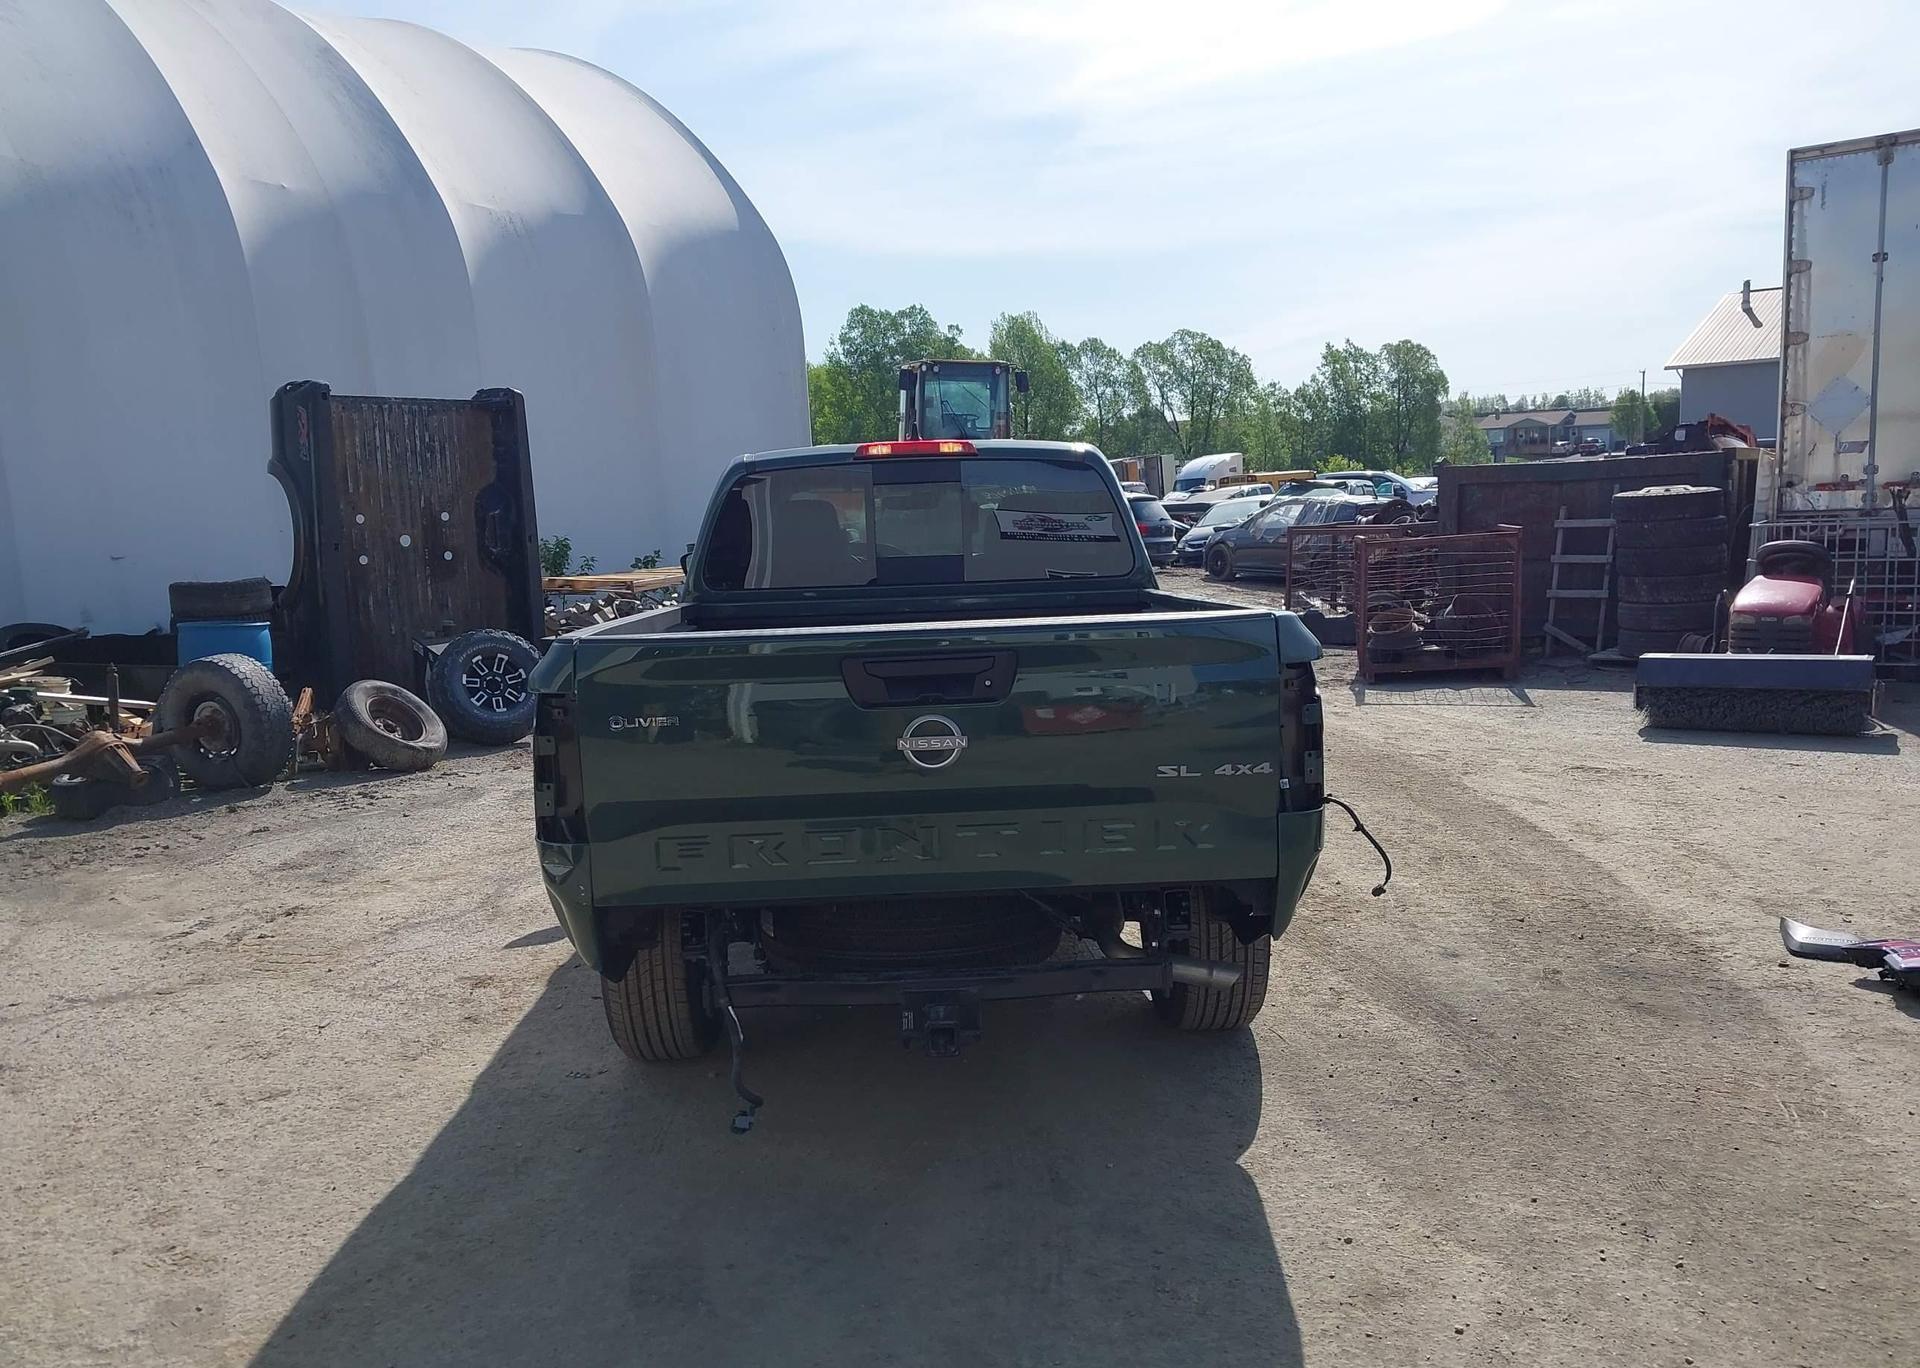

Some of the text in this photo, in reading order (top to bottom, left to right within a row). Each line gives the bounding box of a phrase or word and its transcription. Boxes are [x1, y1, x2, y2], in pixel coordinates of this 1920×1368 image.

[608, 715, 679, 731] OLIVIER
[899, 738, 966, 748] NISSAN
[1156, 765, 1202, 777] SL
[655, 816, 1216, 871] FRONTIER
